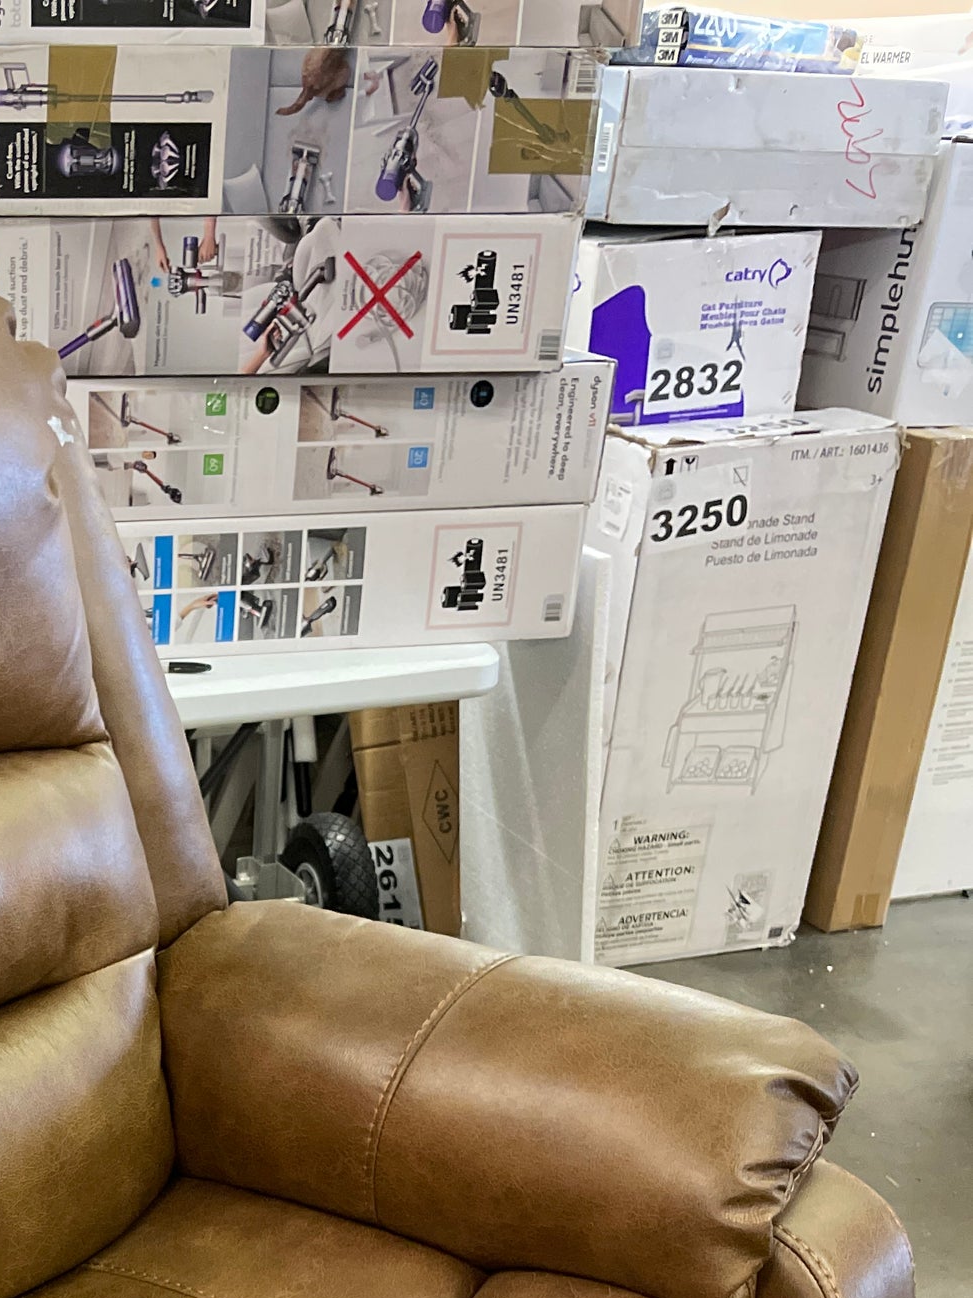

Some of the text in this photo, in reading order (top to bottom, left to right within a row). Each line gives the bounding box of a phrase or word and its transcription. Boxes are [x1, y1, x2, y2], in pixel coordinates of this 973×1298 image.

[661, 14, 679, 26] 3M
[661, 32, 678, 43] 3M
[657, 50, 675, 61] 3M
[872, 51, 911, 64] WARMER
[8, 256, 17, 291] suction
[725, 267, 768, 283] catry
[21, 274, 29, 293] and
[504, 262, 526, 326] UN3481
[20, 296, 29, 316] dust
[700, 307, 786, 321] Meubles Pour Chats
[701, 300, 763, 312] Cat Furniture
[21, 317, 30, 330] up
[648, 359, 743, 402] 2832
[590, 375, 603, 410] dyson
[547, 377, 568, 479] clean, everywhere.
[588, 412, 597, 427] v11
[557, 377, 579, 481] Engineered to deep
[790, 448, 812, 461] ITM.
[848, 442, 889, 457] 1601436
[870, 475, 883, 486] 3+
[650, 494, 748, 543] 3250
[782, 513, 816, 526] Stand
[746, 535, 762, 546] de
[763, 530, 819, 546] Limonade
[705, 547, 819, 567] Puesto de Limonada
[490, 548, 509, 602] UN3481
[434, 789, 453, 833] CWC
[633, 830, 690, 845] WARNING:
[625, 865, 696, 882] ATTENTION:
[618, 908, 689, 926] ADVERTENCIA:
